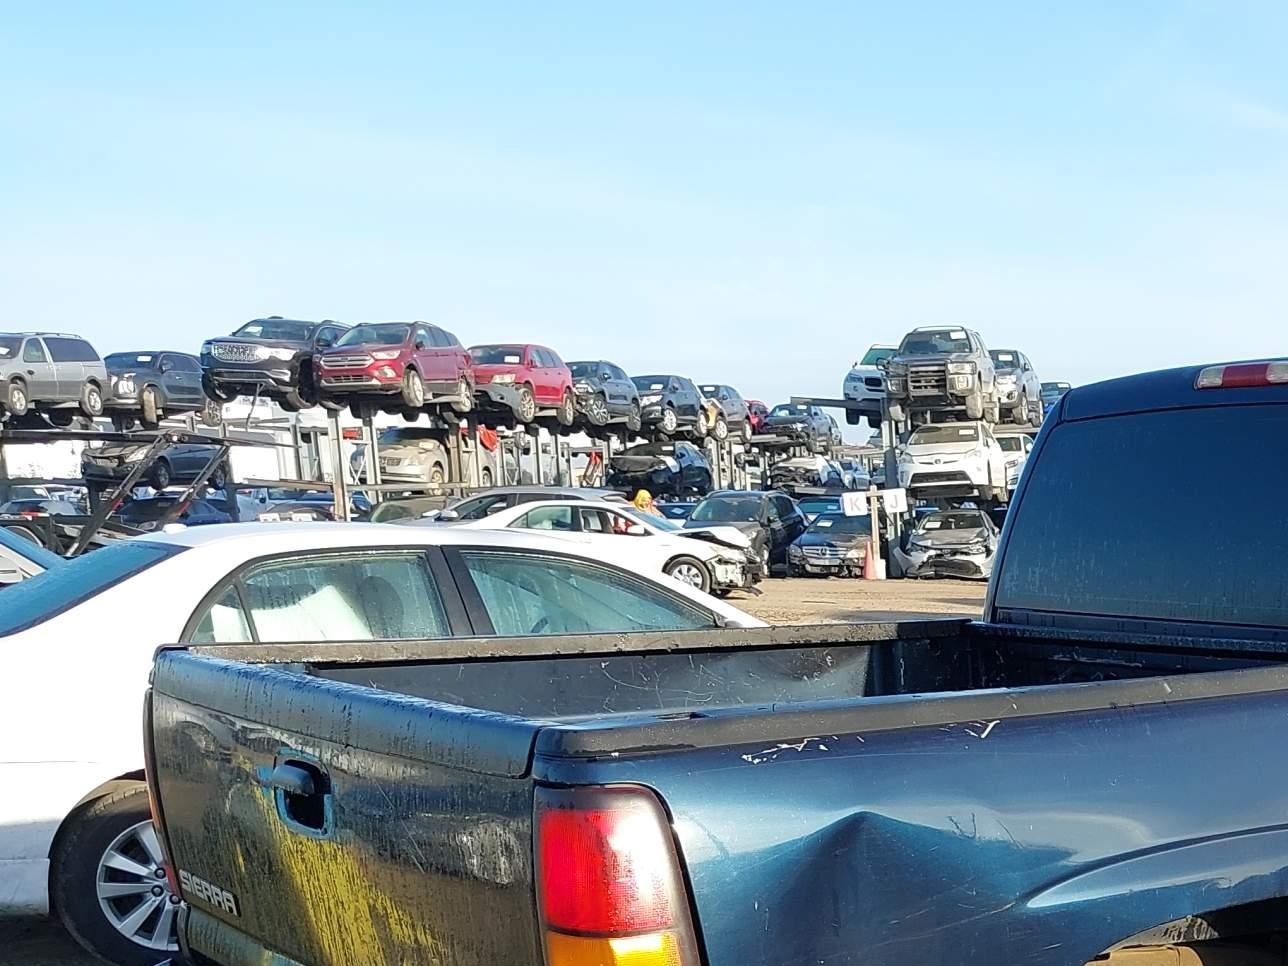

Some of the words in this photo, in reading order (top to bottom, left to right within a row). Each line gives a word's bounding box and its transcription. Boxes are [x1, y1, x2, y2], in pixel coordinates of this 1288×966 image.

[849, 496, 861, 512] K
[889, 494, 898, 509] J
[178, 868, 239, 917] SIERRA
